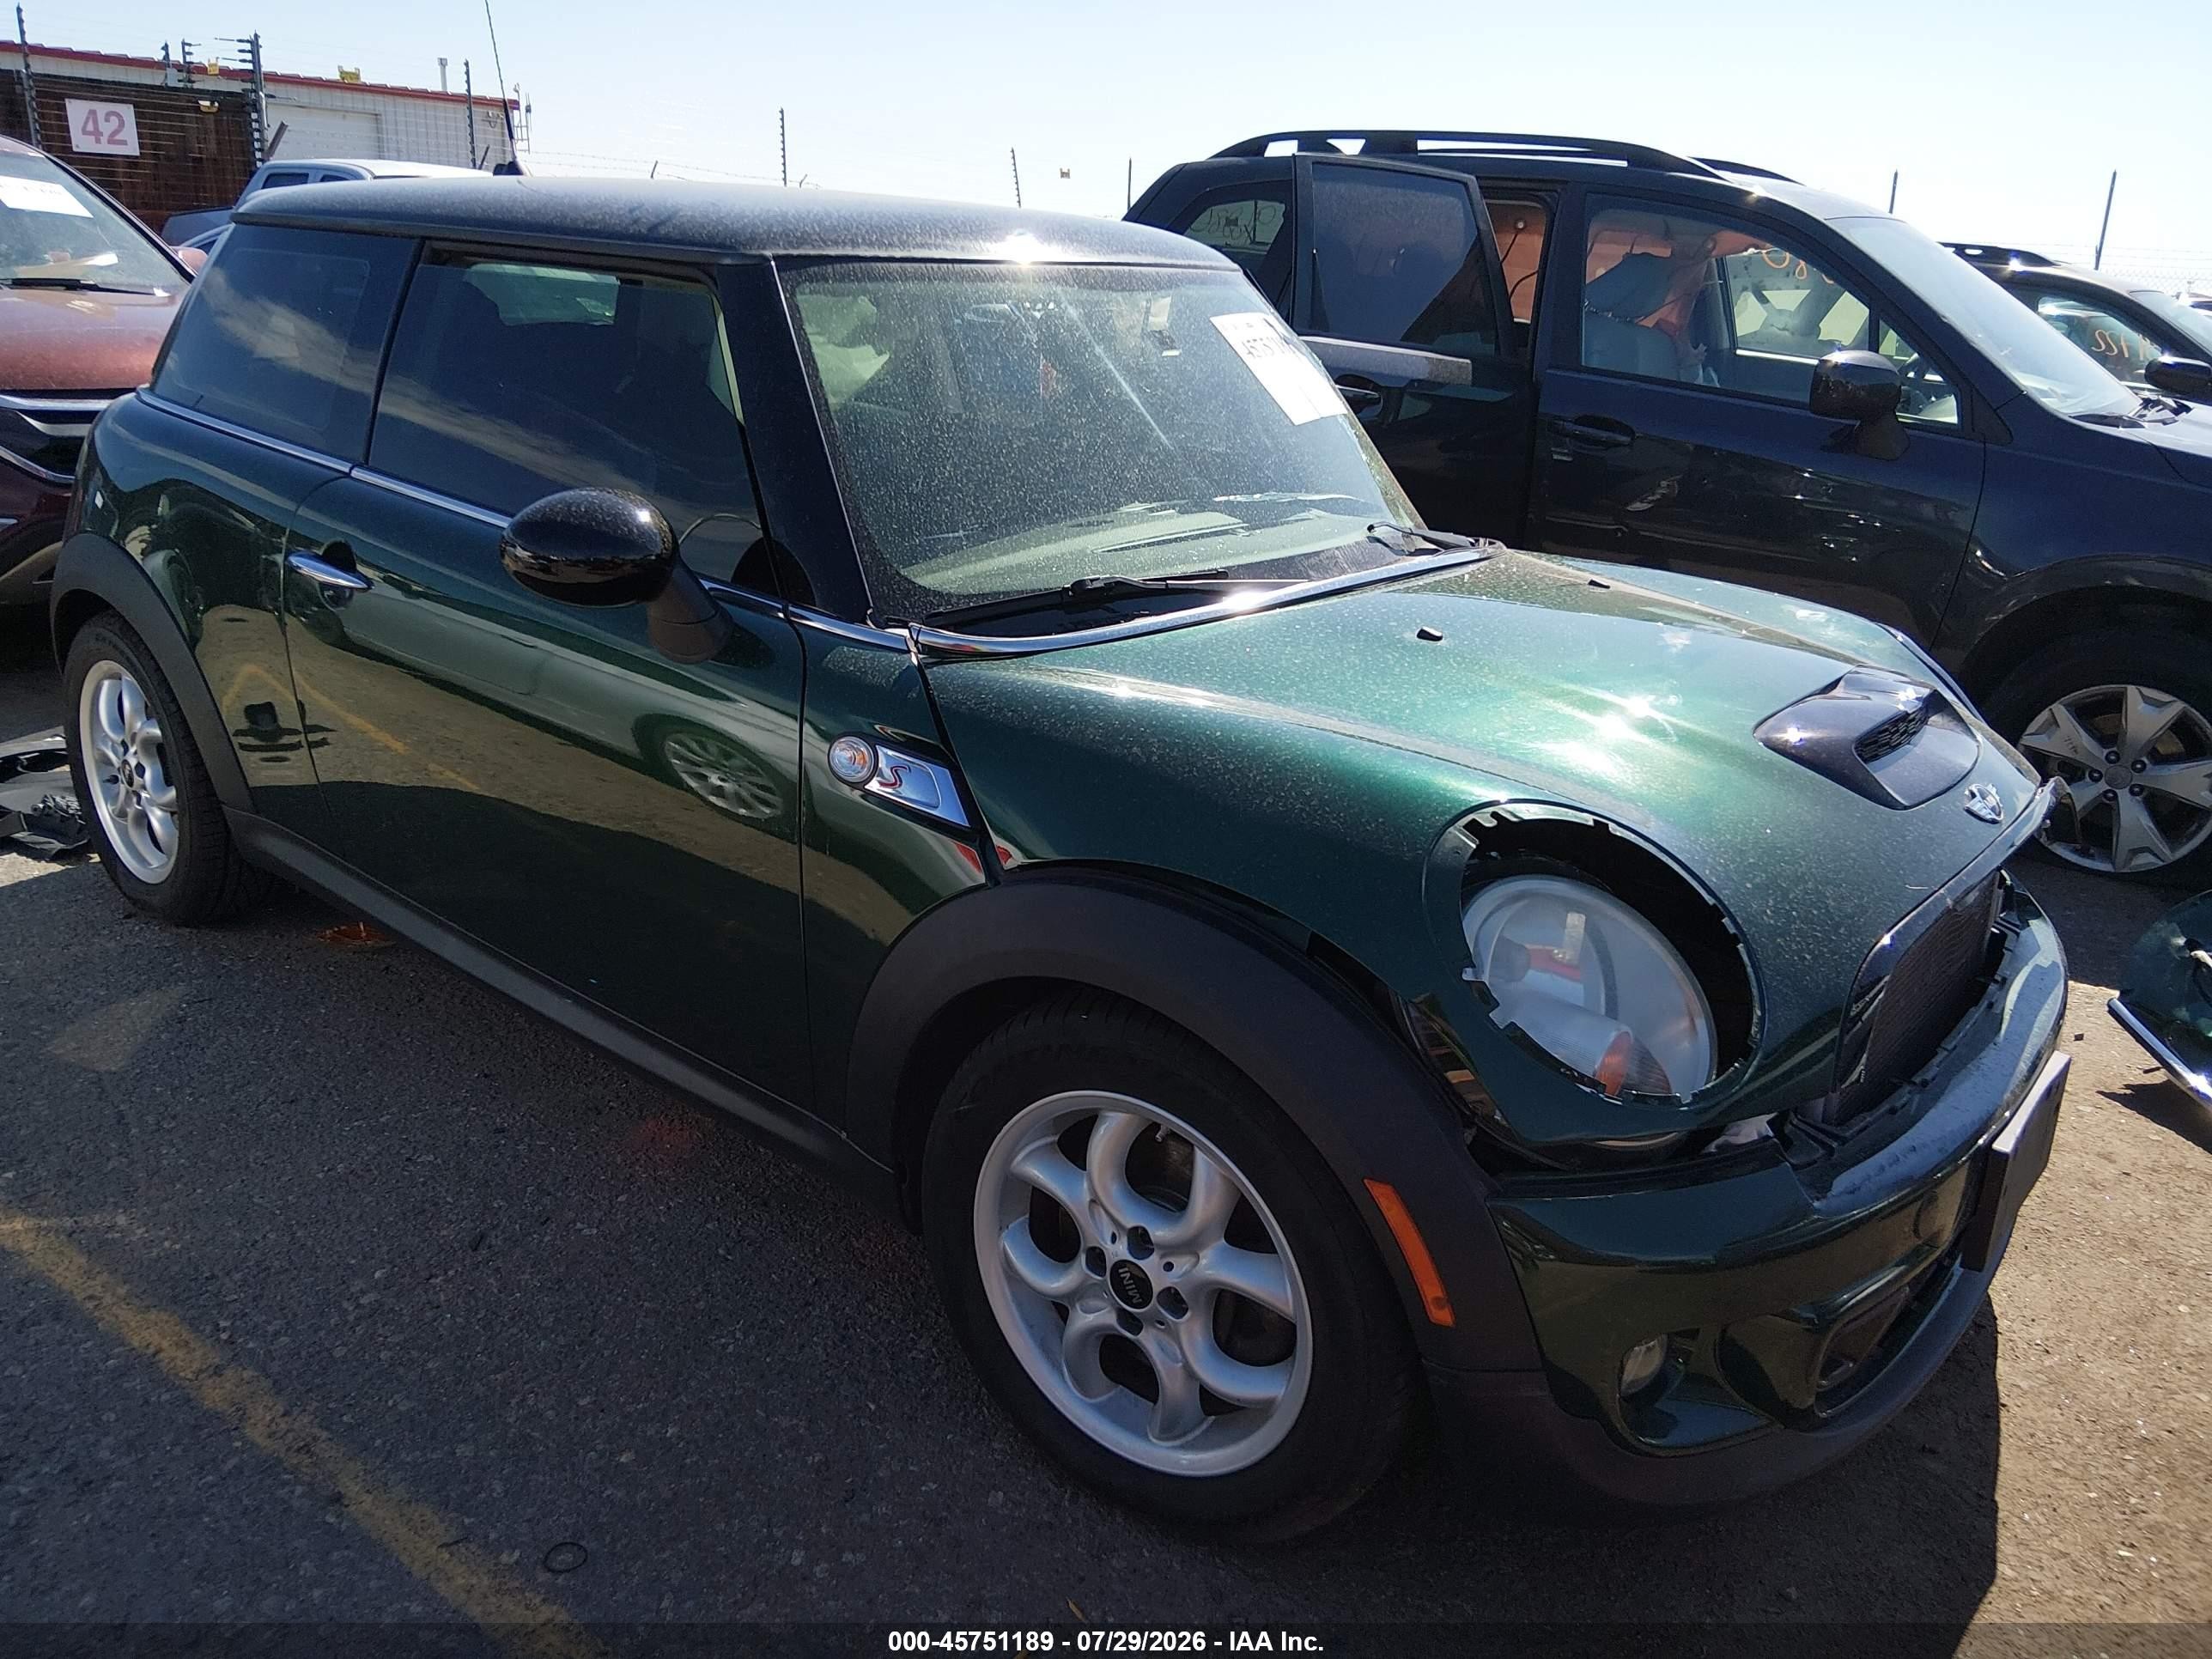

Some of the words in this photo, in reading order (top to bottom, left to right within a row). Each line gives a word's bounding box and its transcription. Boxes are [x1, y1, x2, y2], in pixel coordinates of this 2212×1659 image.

[82, 109, 128, 145] 42
[878, 765, 911, 788] S
[1118, 1267, 1142, 1304] MINI
